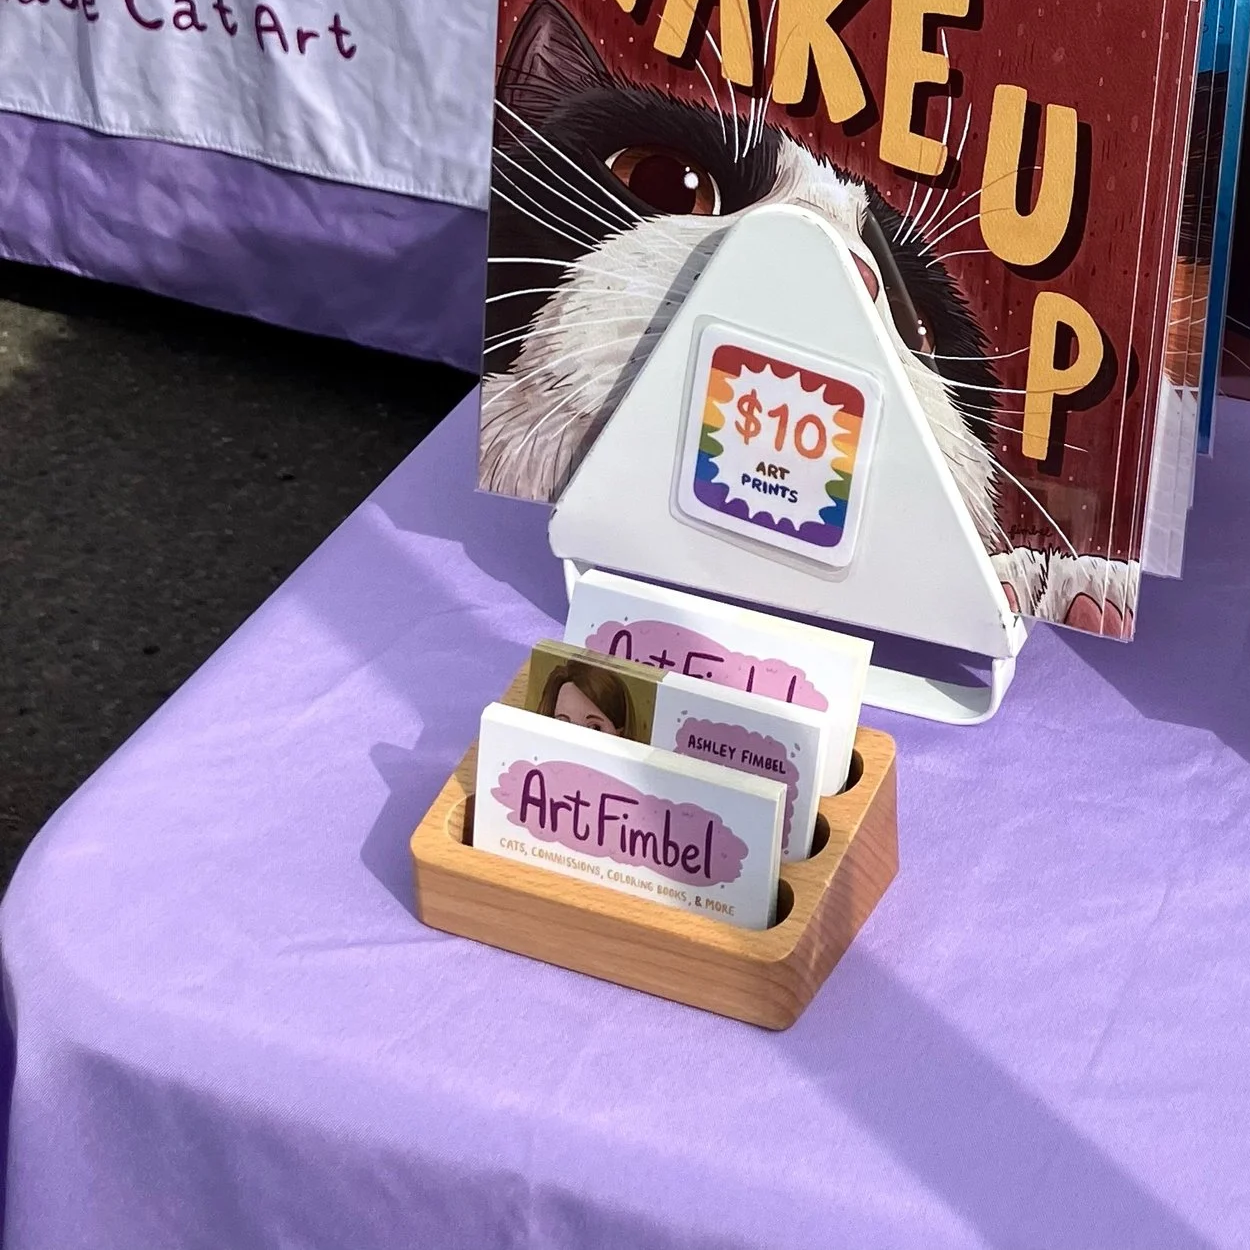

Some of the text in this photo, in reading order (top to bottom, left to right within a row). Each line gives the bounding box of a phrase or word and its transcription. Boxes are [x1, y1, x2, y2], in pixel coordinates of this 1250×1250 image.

[254, 2, 357, 60] Art
[735, 389, 827, 460] $10
[740, 473, 799, 503] PRINTS
[755, 461, 791, 480] ART
[687, 734, 787, 775] ASHLEY FIMBEL
[499, 837, 528, 856] CATS,
[531, 845, 604, 880] COMMISSIONS,
[606, 868, 654, 892] COLORING
[694, 894, 704, 907] &
[704, 899, 737, 917] MORE
